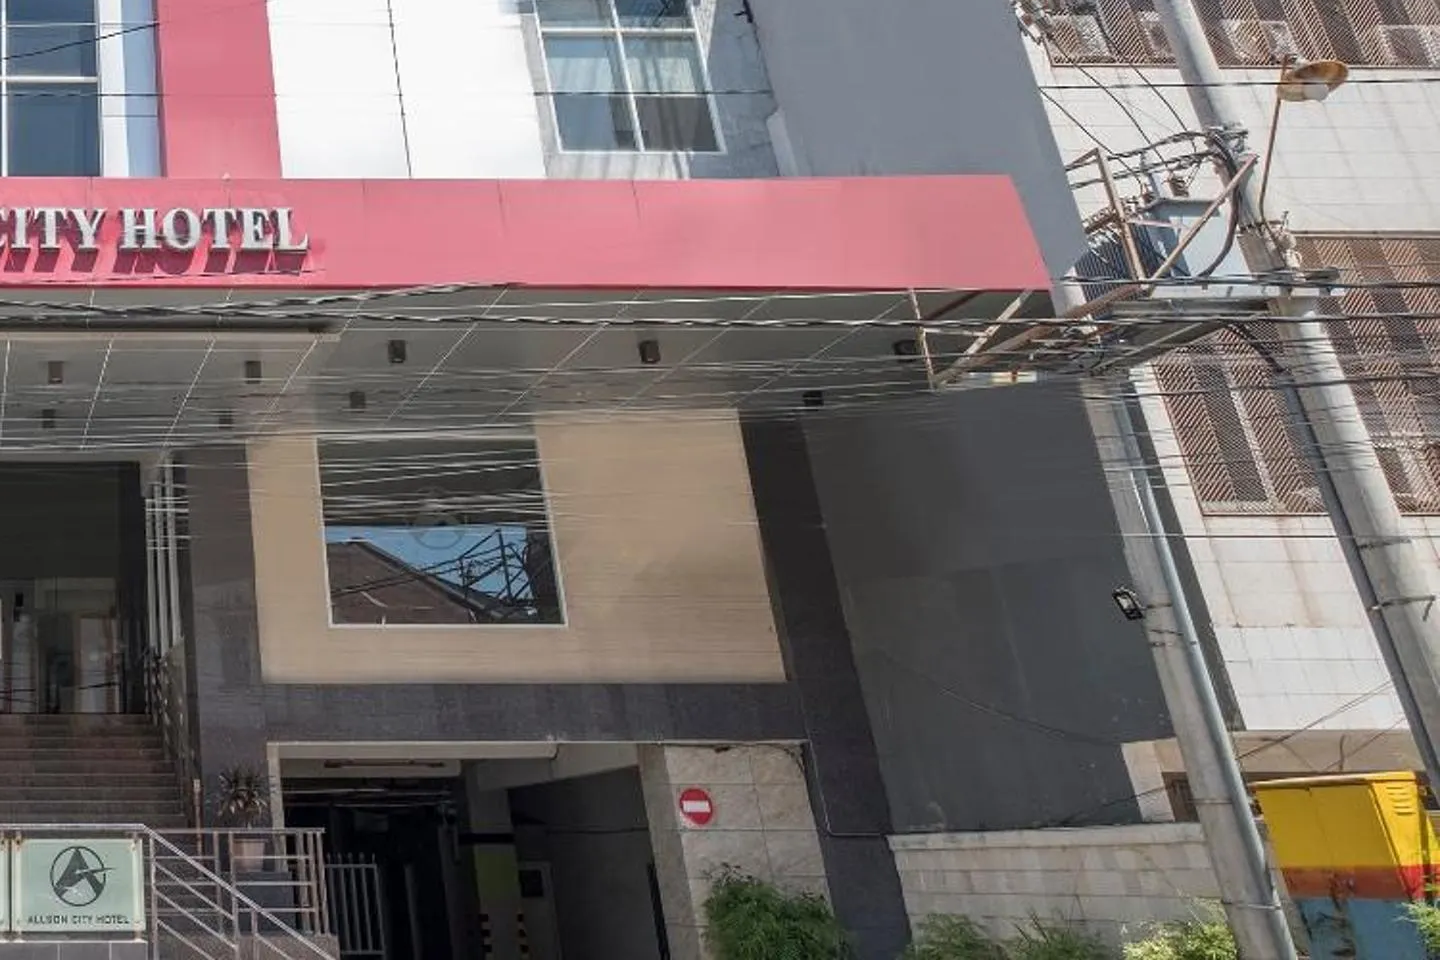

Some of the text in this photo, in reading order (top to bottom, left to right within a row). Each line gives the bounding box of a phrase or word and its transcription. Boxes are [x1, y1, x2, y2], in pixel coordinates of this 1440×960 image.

[120, 206, 309, 253] HOTEL
[27, 914, 130, 925] ALLSON CITY HOTEL
